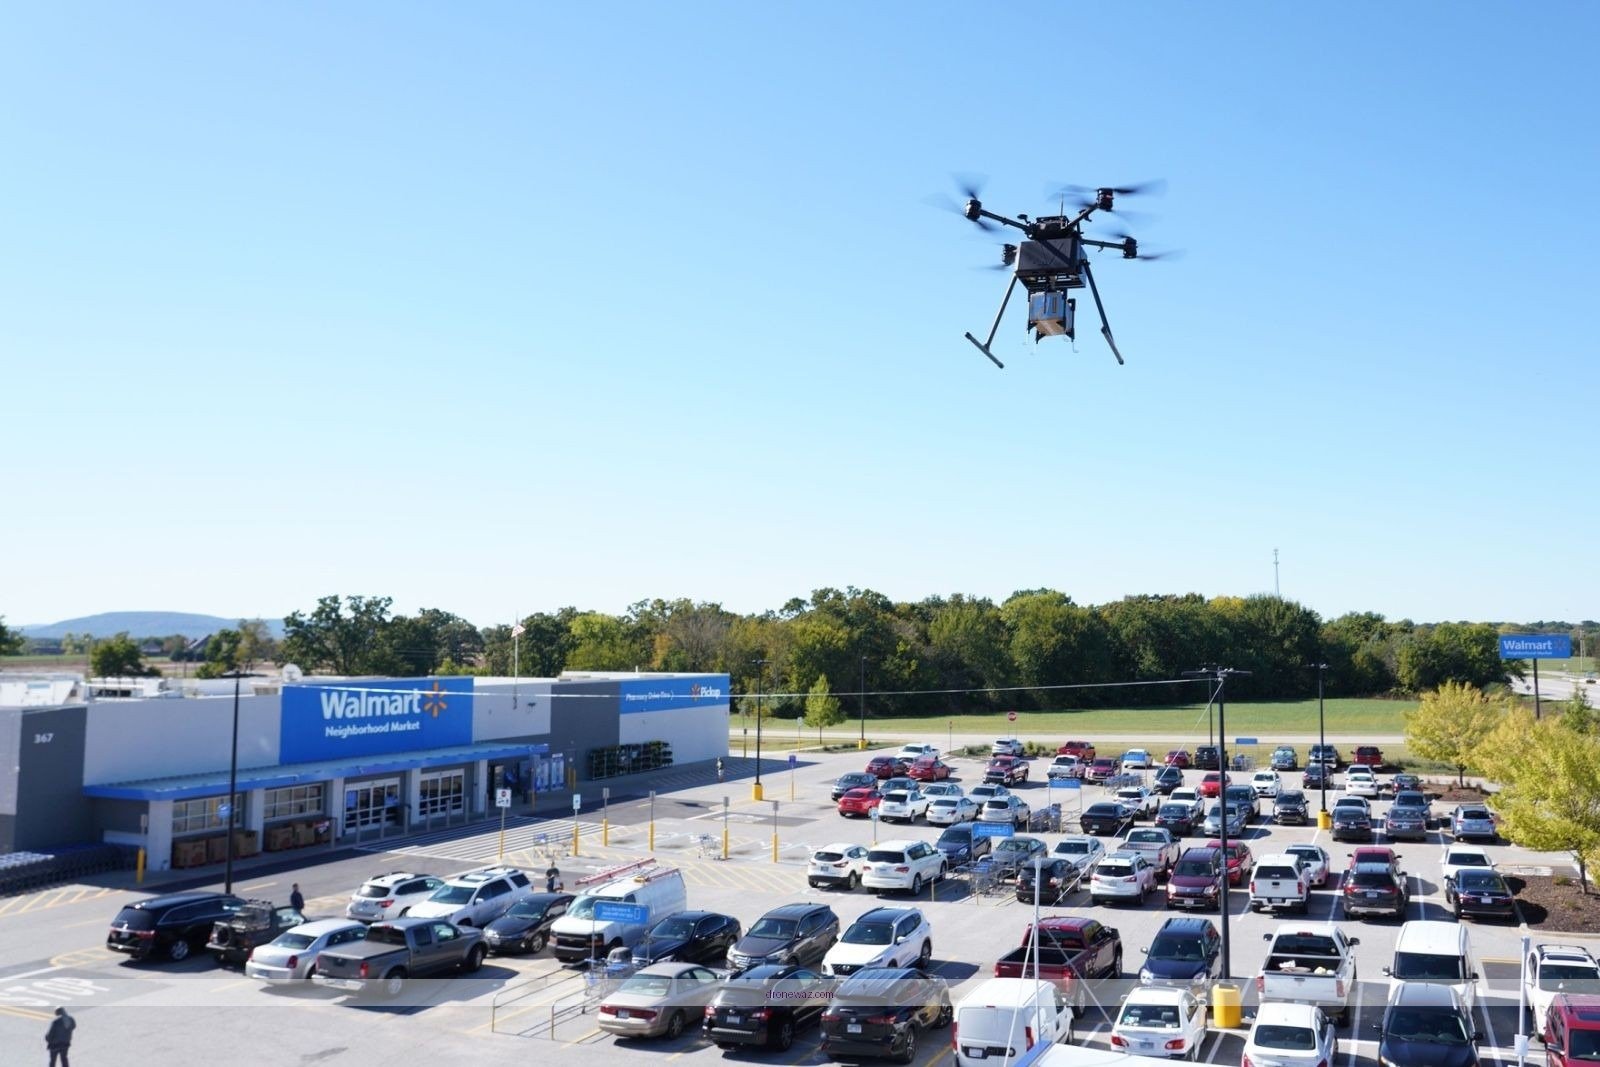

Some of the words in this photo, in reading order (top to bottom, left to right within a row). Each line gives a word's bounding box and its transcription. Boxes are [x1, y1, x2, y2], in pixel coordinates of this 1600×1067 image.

[1503, 640, 1552, 650] Walmart
[700, 686, 721, 699] Pickup
[320, 688, 421, 719] Walmart
[325, 721, 389, 739] Neighborhood
[391, 720, 420, 732] Market
[33, 732, 54, 744] 367
